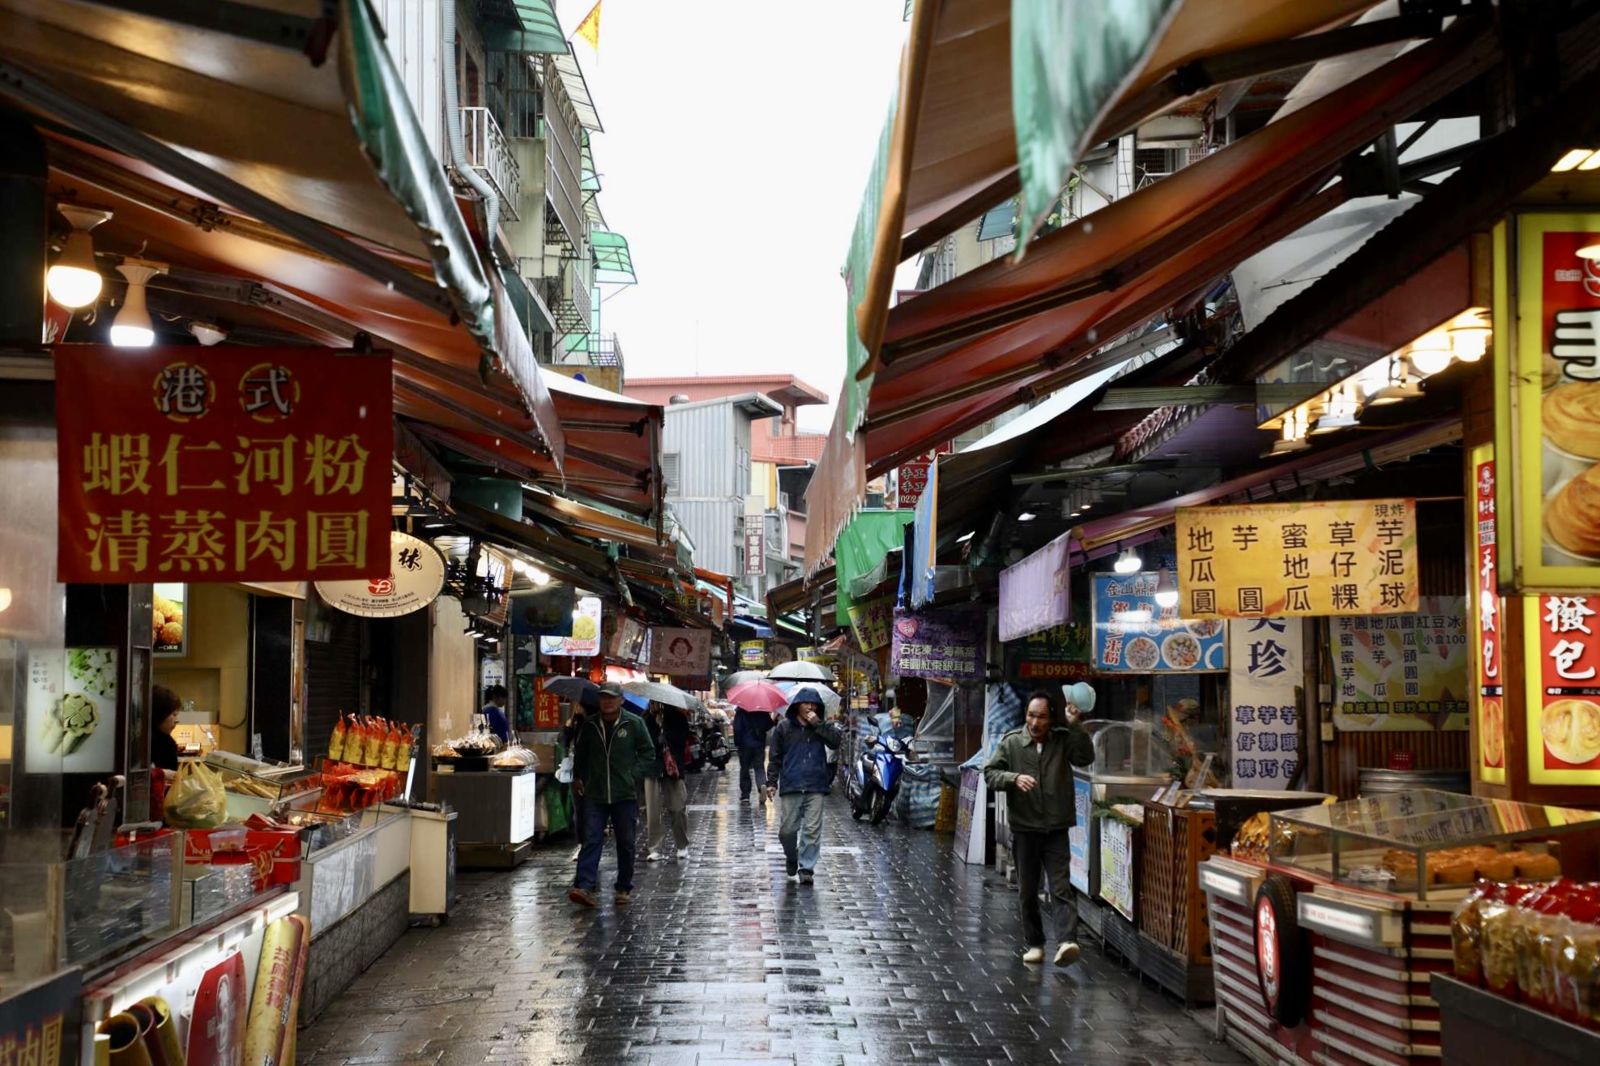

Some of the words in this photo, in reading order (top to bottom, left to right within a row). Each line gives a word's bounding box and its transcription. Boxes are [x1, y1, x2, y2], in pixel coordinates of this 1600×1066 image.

[160, 367, 291, 416] 港式
[82, 431, 370, 496] 蝦仁河粉
[84, 509, 370, 573] 清蒸肉圓
[1374, 503, 1405, 518] 現炸
[1187, 526, 1217, 615] 地瓜圓
[1231, 524, 1264, 613] 芋圓
[1280, 522, 1312, 612] 蜜地瓜
[1328, 520, 1359, 610] 草仔粿
[1376, 519, 1406, 608] 芋泥球
[1339, 632, 1418, 647] 蜜地瓜
[1340, 650, 1418, 664] 蜜芋頭
[1544, 596, 1598, 680] 撥包
